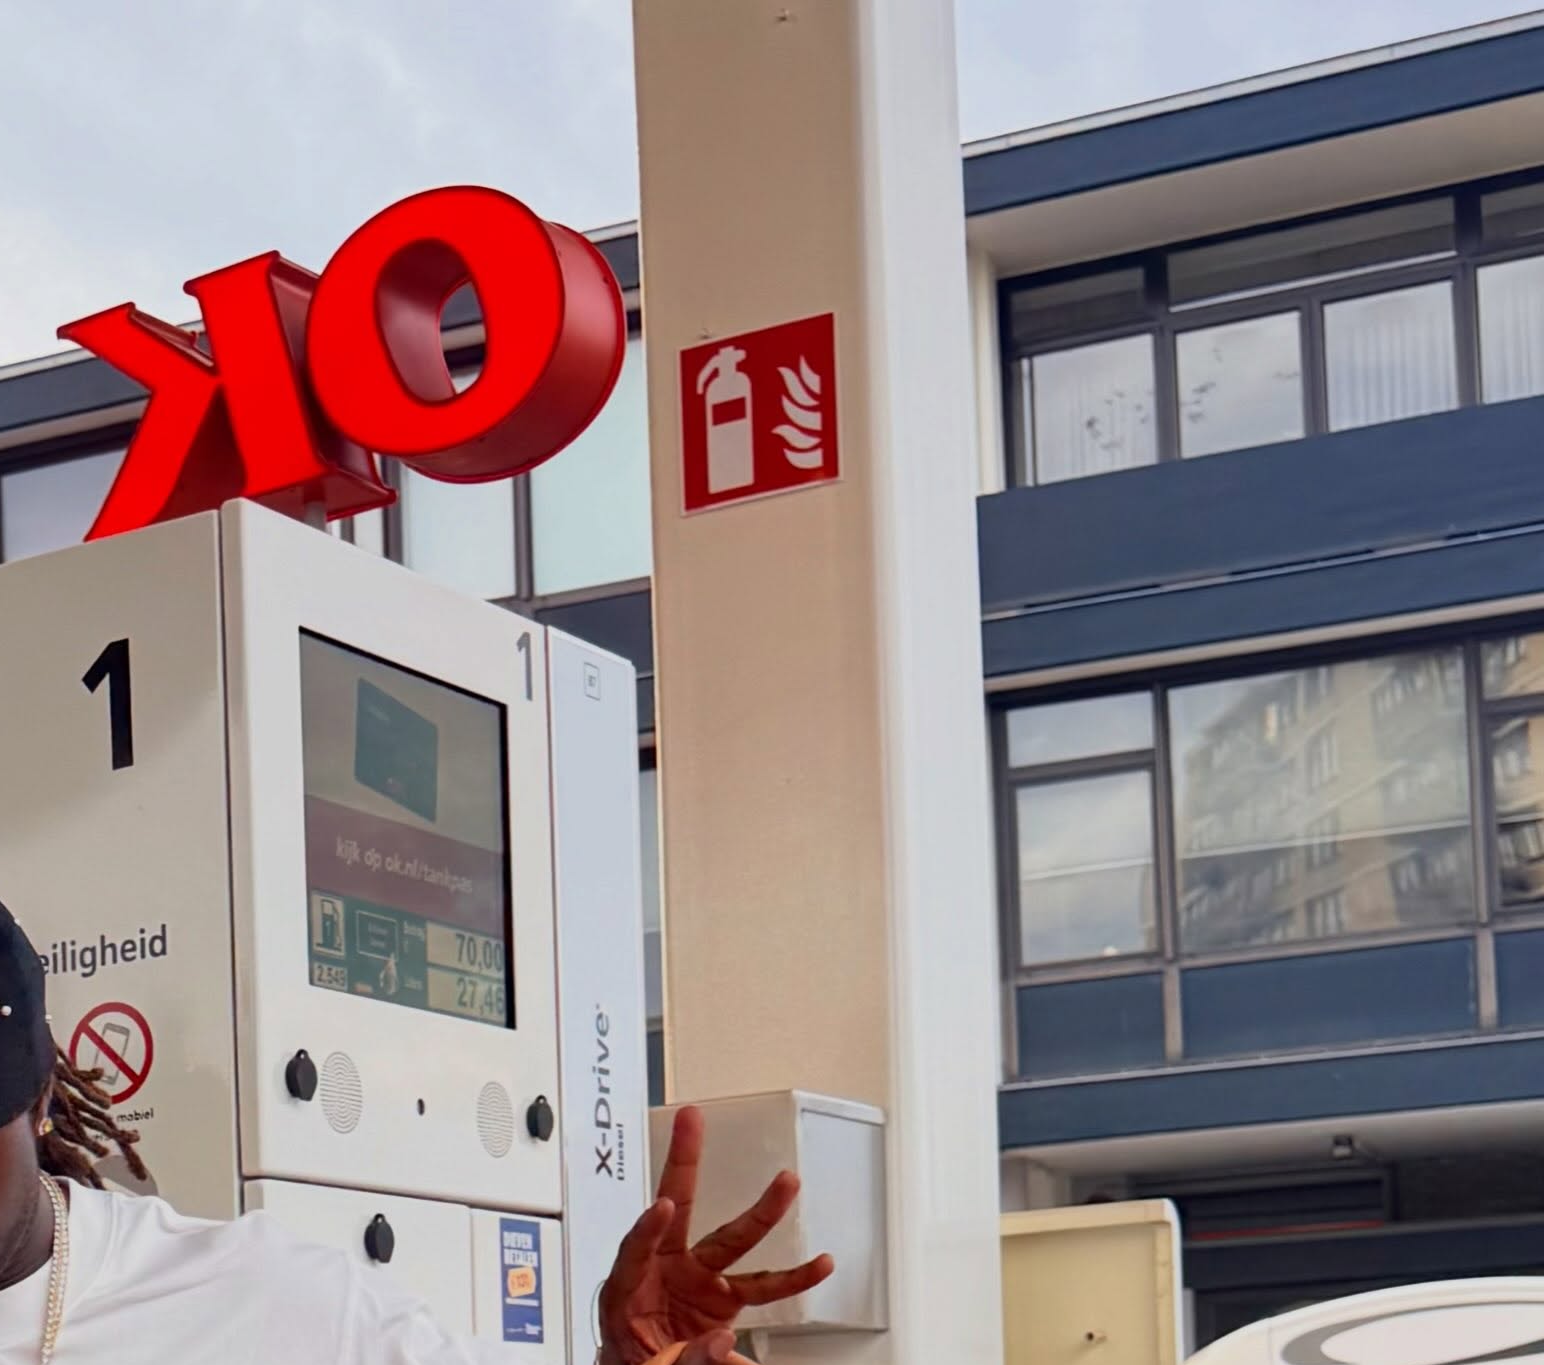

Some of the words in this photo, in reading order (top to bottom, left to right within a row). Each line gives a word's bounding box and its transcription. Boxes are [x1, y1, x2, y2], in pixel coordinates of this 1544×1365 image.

[516, 631, 532, 701] 1
[82, 638, 134, 770] 1
[335, 836, 361, 866] kijk
[364, 848, 382, 871] op
[38, 924, 167, 978] eiligheid
[591, 1009, 613, 1178] X-Drive
